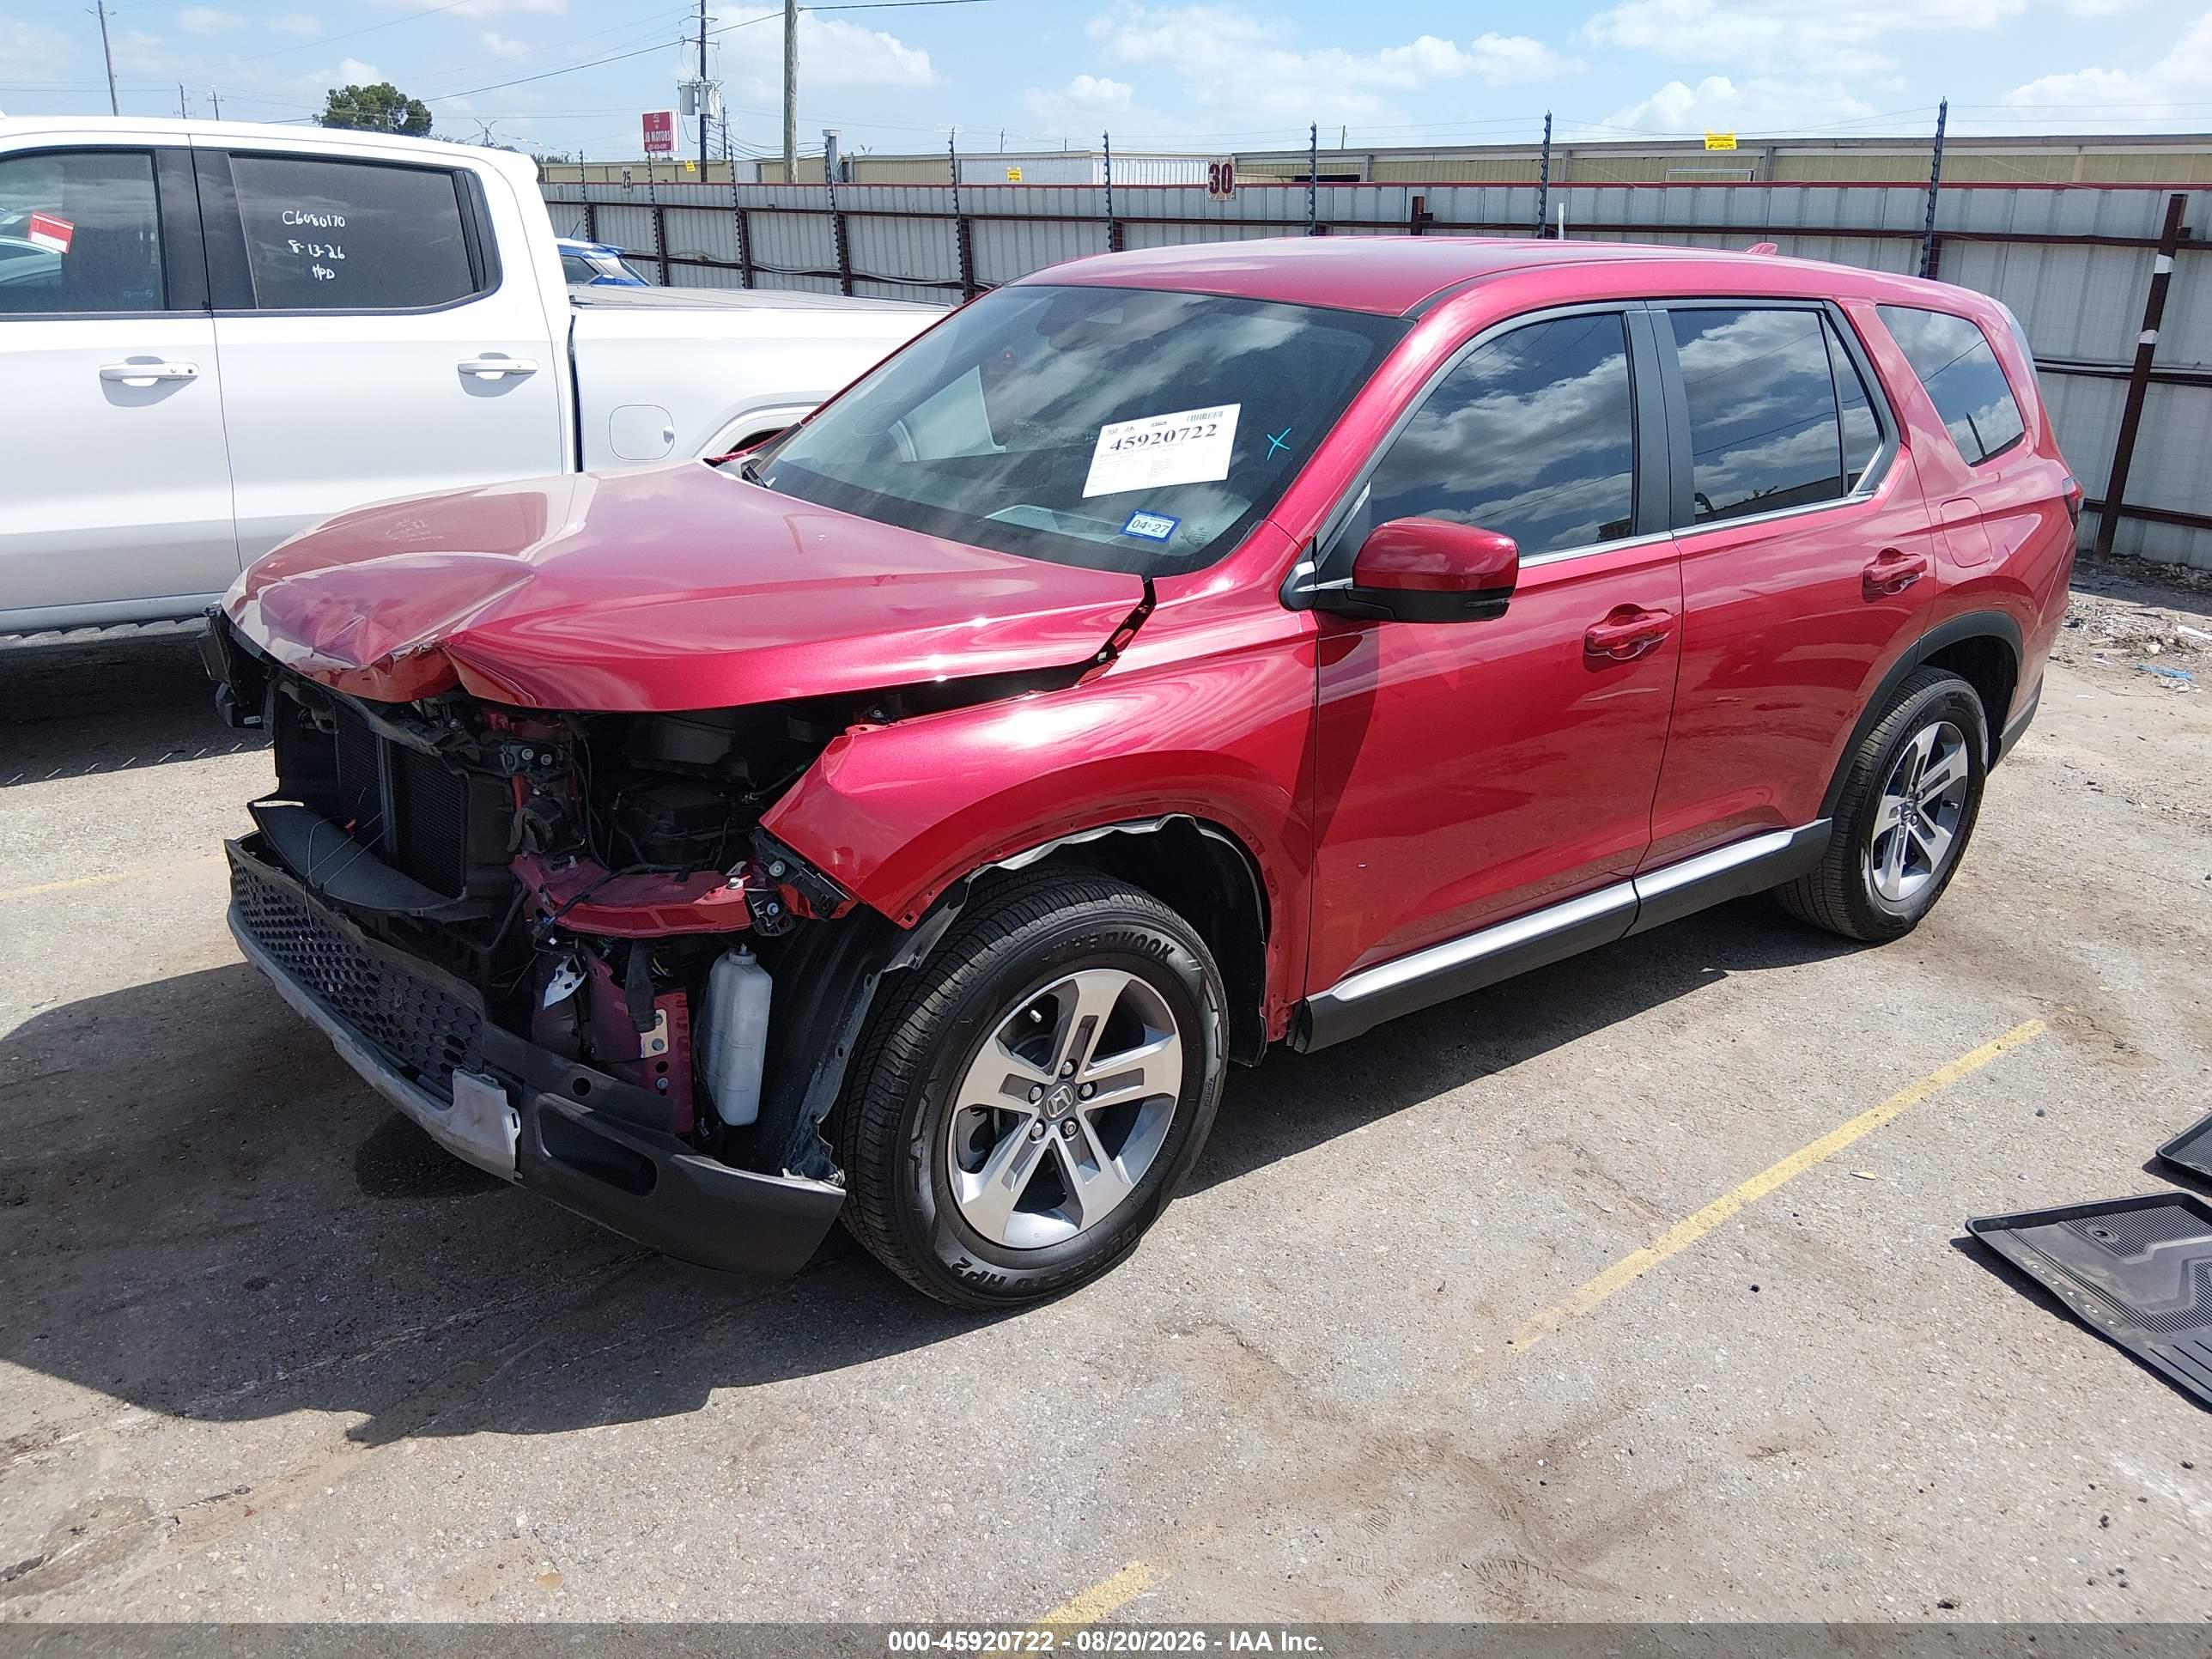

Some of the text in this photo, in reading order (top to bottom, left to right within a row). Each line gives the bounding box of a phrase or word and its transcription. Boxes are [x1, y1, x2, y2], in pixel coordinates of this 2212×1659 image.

[651, 130, 671, 142] MOTORS
[623, 171, 631, 189] 25
[1209, 163, 1233, 194] 30
[282, 210, 345, 228] C6080170
[1109, 423, 1218, 451] 45920722
[1132, 519, 1170, 533] 04 27
